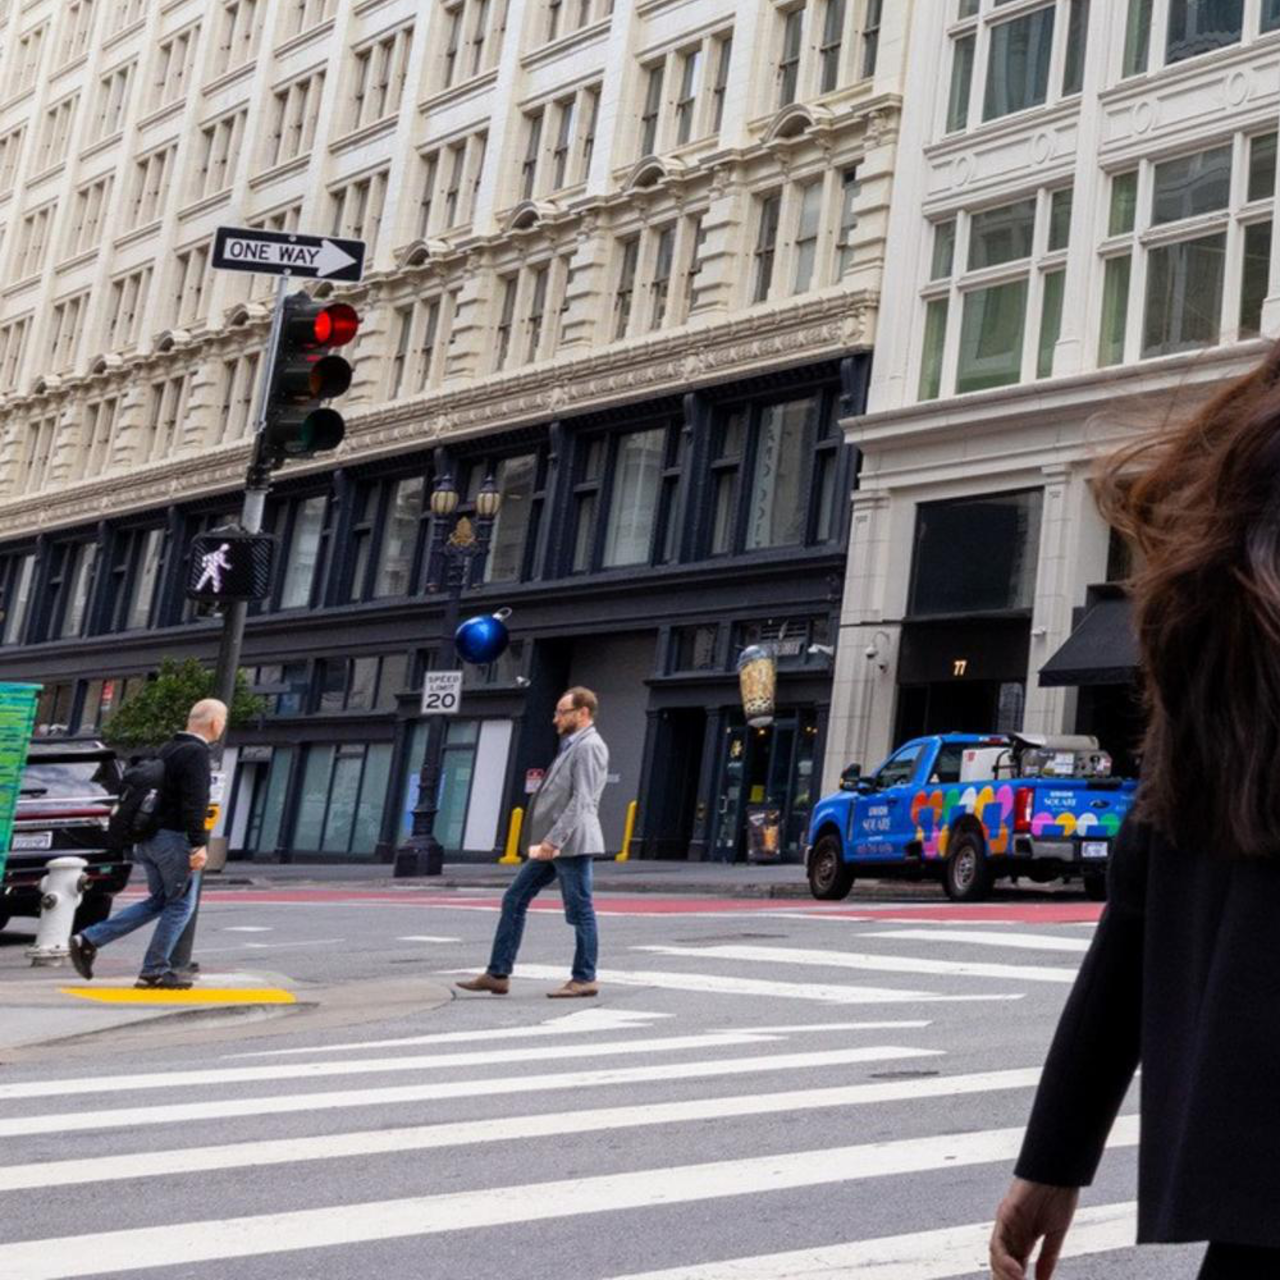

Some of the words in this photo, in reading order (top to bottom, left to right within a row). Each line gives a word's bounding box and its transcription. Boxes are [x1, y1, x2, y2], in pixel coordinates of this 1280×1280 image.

[230, 241, 271, 261] ONE
[279, 246, 320, 265] WAY
[426, 693, 456, 709] 20
